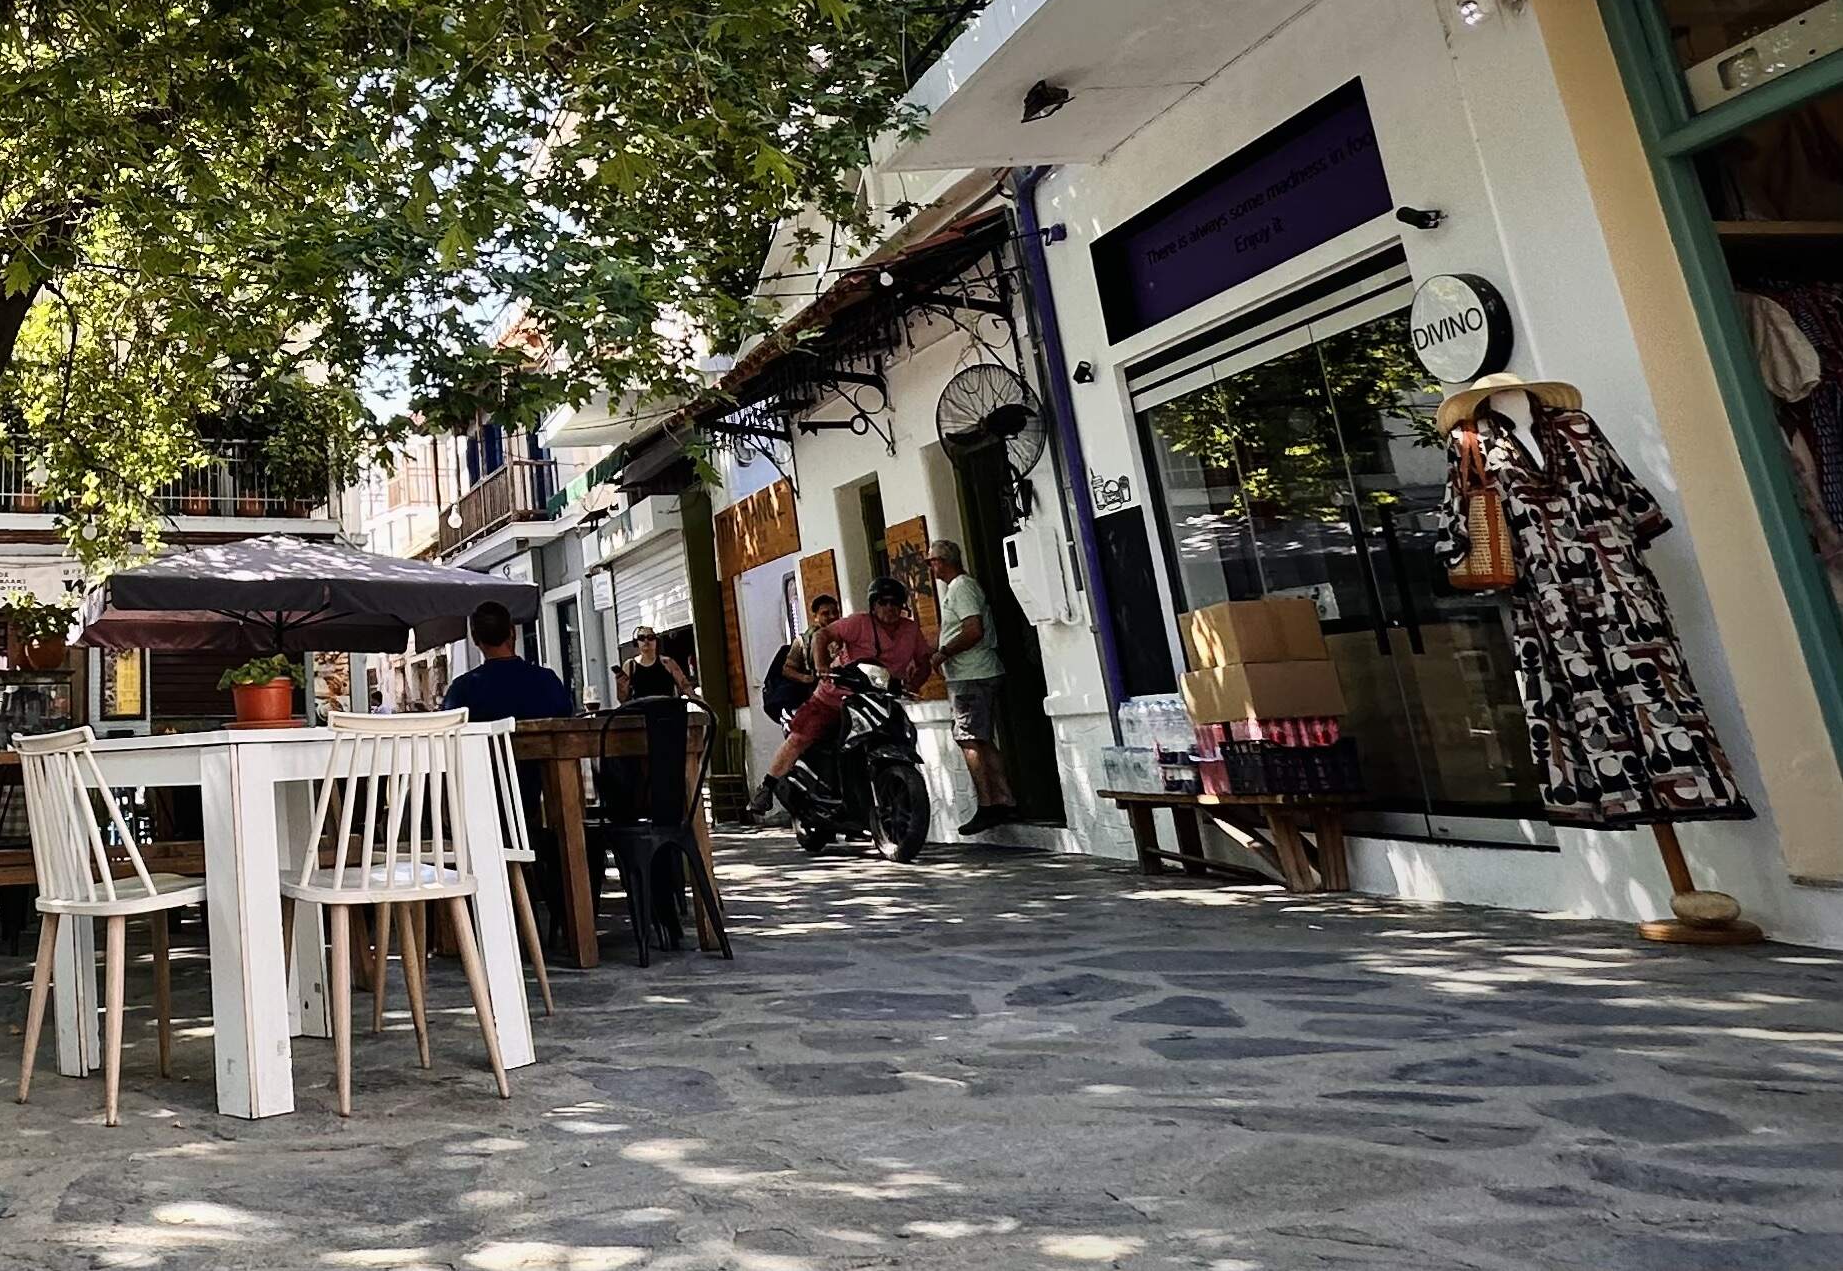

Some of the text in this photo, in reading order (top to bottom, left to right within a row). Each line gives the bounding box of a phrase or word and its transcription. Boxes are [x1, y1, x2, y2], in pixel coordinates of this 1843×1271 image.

[1146, 240, 1177, 265] There
[1189, 213, 1230, 245] always
[1229, 192, 1265, 221] some
[1266, 154, 1328, 201] madness
[1326, 146, 1346, 166] in
[1347, 129, 1375, 157] foo
[1233, 225, 1270, 254] Enjoy
[1413, 307, 1483, 351] DIVINO
